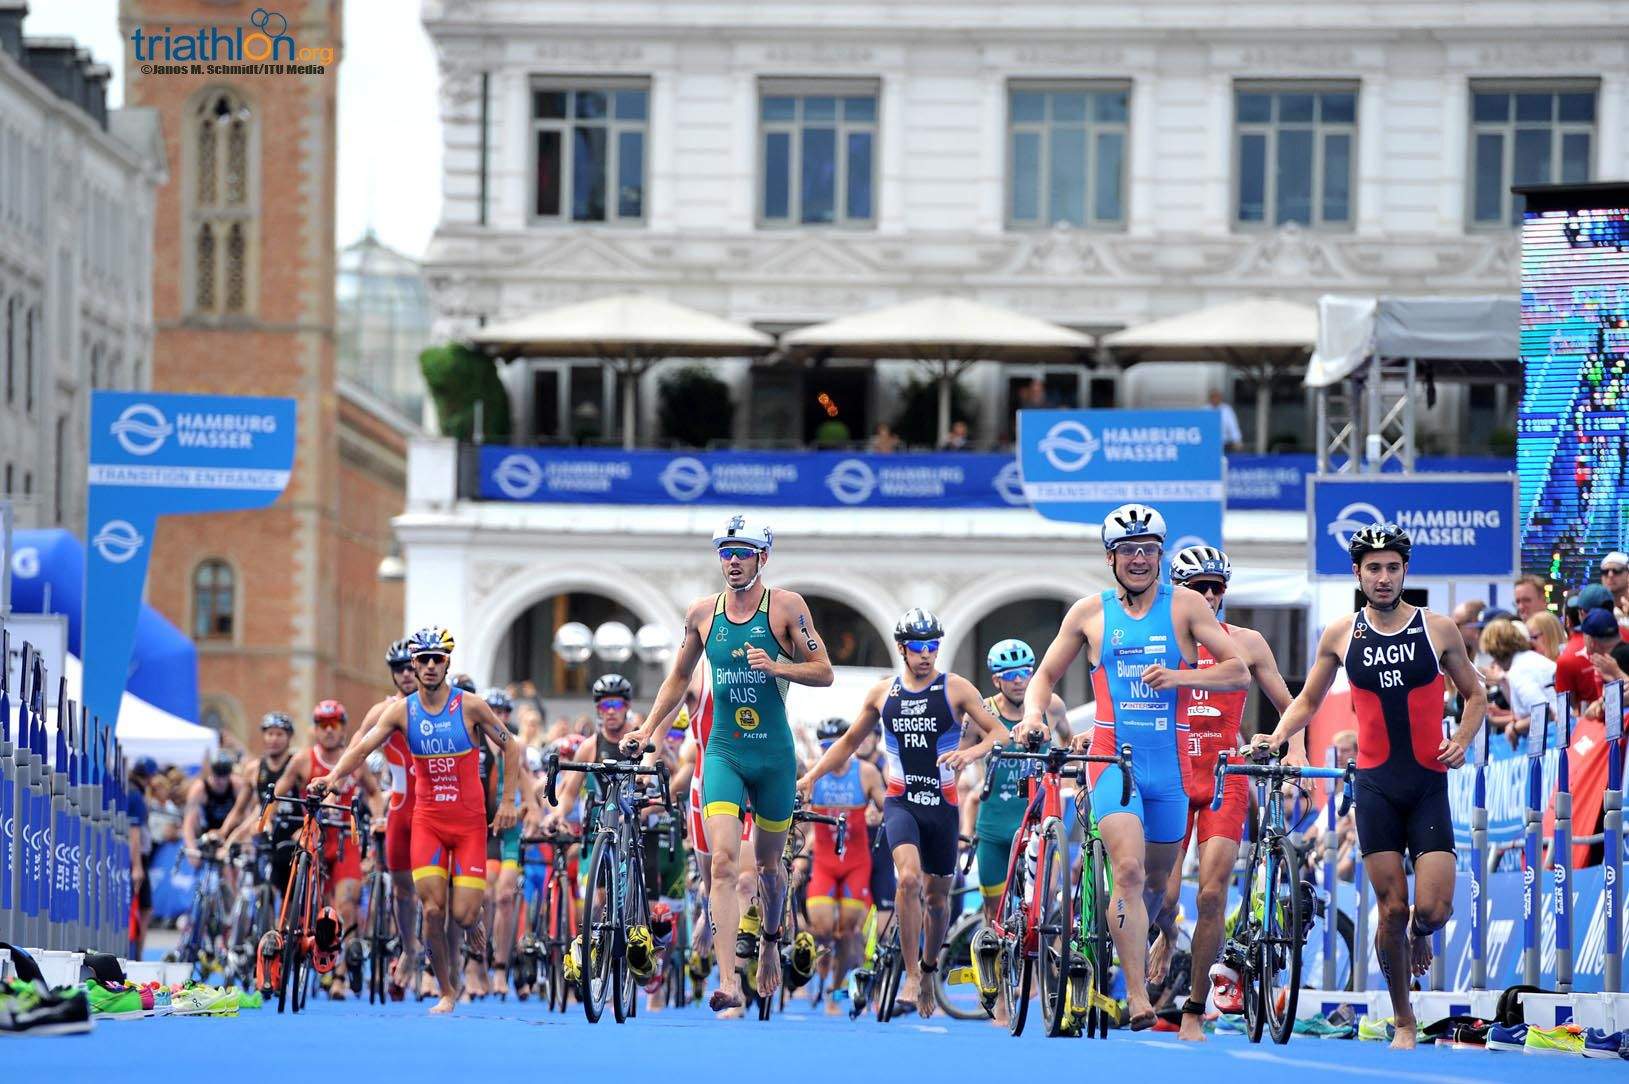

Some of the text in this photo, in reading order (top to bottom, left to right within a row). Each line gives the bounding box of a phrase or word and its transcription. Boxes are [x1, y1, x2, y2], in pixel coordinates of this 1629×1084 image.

[176, 413, 276, 433] HAMBURG
[178, 430, 251, 449] WASSER
[1102, 427, 1201, 445] HAMBURG
[1104, 445, 1178, 462] WASSER
[96, 468, 277, 485] TRANSITION ENTRANCE
[545, 461, 631, 480] HAMBURG
[713, 462, 797, 483] HAMBURG
[880, 464, 963, 484] HAMBURG
[1038, 484, 1212, 498] TRANSITION ENTRANCE
[1397, 510, 1500, 528] HAMBURG
[1402, 528, 1476, 546] WASSER
[1362, 641, 1416, 667] SAGIV
[716, 667, 767, 685] Birtwhistle
[1378, 669, 1404, 689] ISR
[730, 687, 757, 703] AUS
[892, 717, 938, 733] BERGERE
[420, 737, 457, 755] MOLA
[904, 733, 929, 749] FRA
[428, 757, 456, 775] ESP
[1116, 914, 1125, 929] 7
